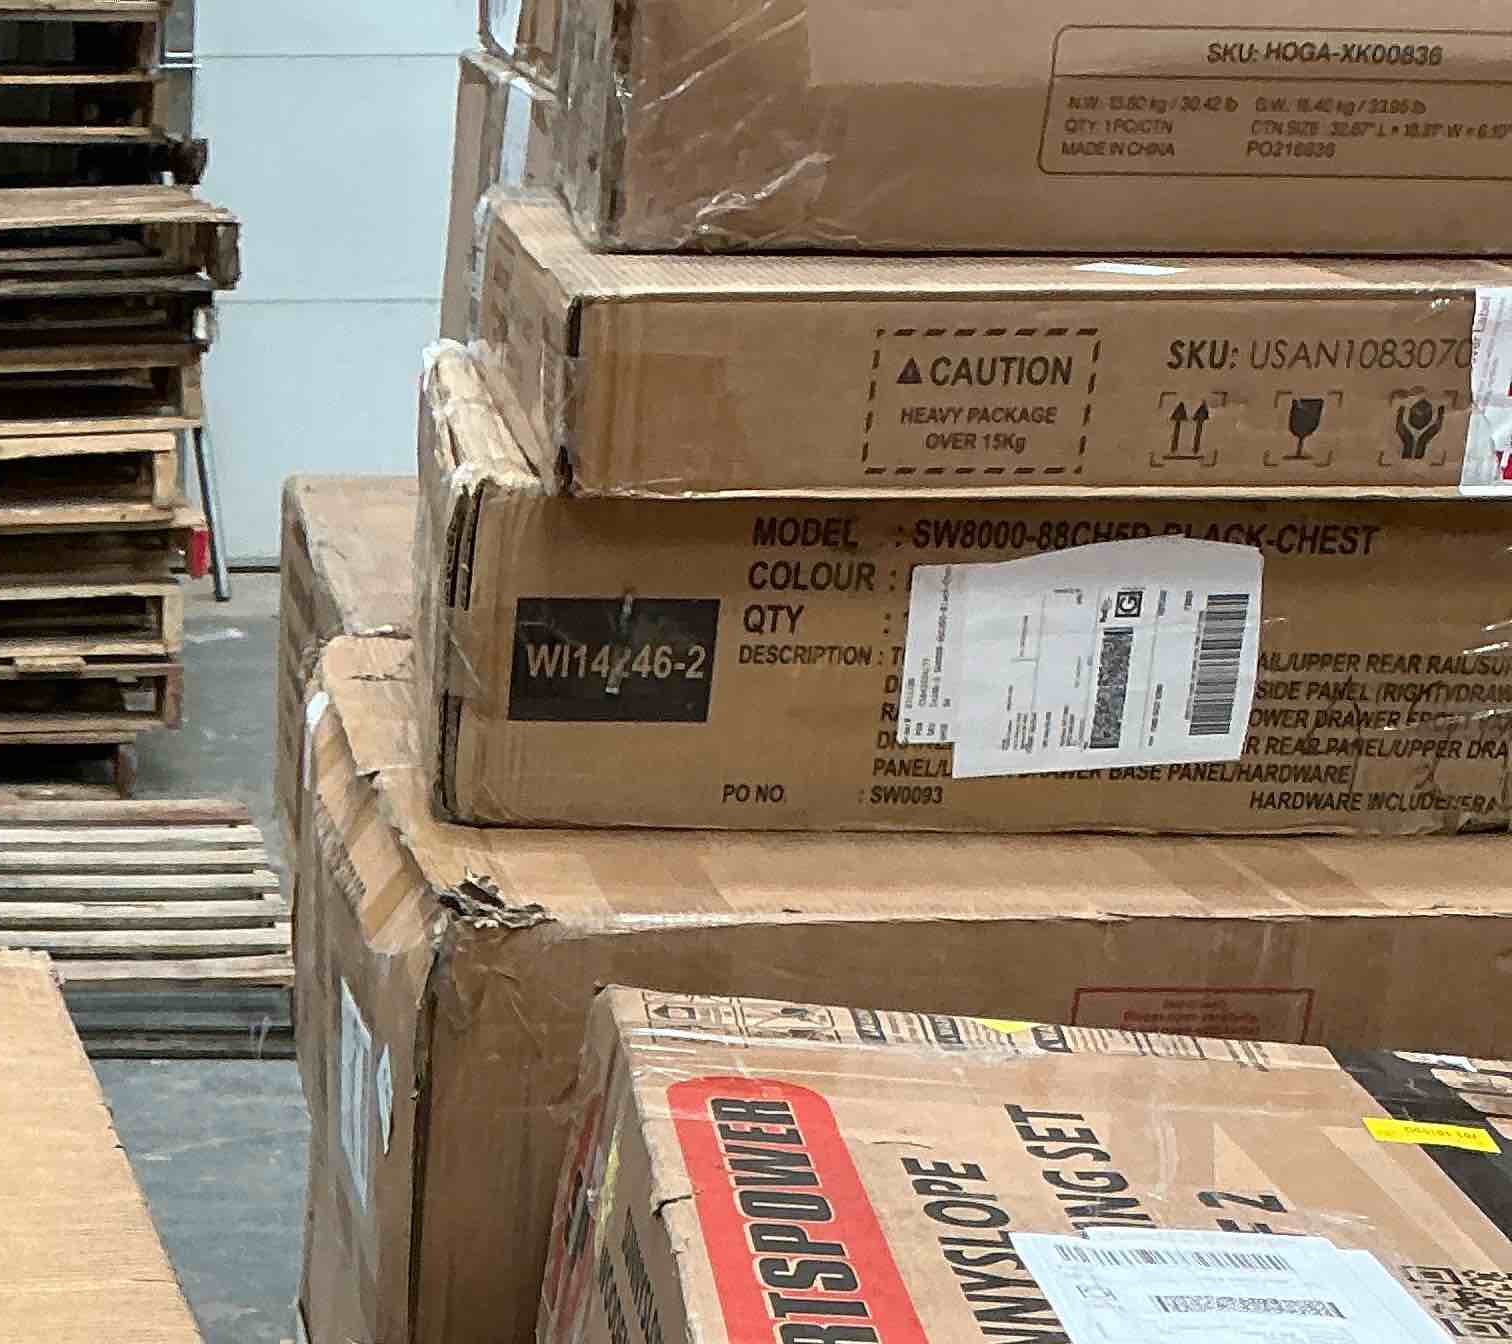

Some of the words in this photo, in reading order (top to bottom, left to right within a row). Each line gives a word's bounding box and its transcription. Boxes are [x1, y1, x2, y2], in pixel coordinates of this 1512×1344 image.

[1207, 42, 1259, 65] SKU:
[1127, 142, 1175, 157] CHINA
[1165, 338, 1239, 371] SKU:
[1249, 337, 1474, 370] USAN1083070
[929, 355, 1073, 386] CAUTION
[899, 405, 961, 425] HEAVY
[967, 405, 1059, 425] PACKAGE
[925, 432, 977, 451] OVER
[982, 432, 1027, 455] 15Kg
[751, 515, 859, 547] MODEL
[748, 559, 876, 592] COLOUR
[742, 603, 805, 635] QTY
[738, 644, 873, 666] DESCRIPTION
[1365, 653, 1421, 674] REAR
[1255, 680, 1300, 701] SIDE
[1306, 680, 1368, 701] PANEL
[1312, 709, 1399, 730] DRAWER
[721, 783, 750, 804] PO
[869, 784, 944, 805] SW0093
[1248, 790, 1363, 812] HARDWARE
[1003, 1103, 1112, 1162] SET
